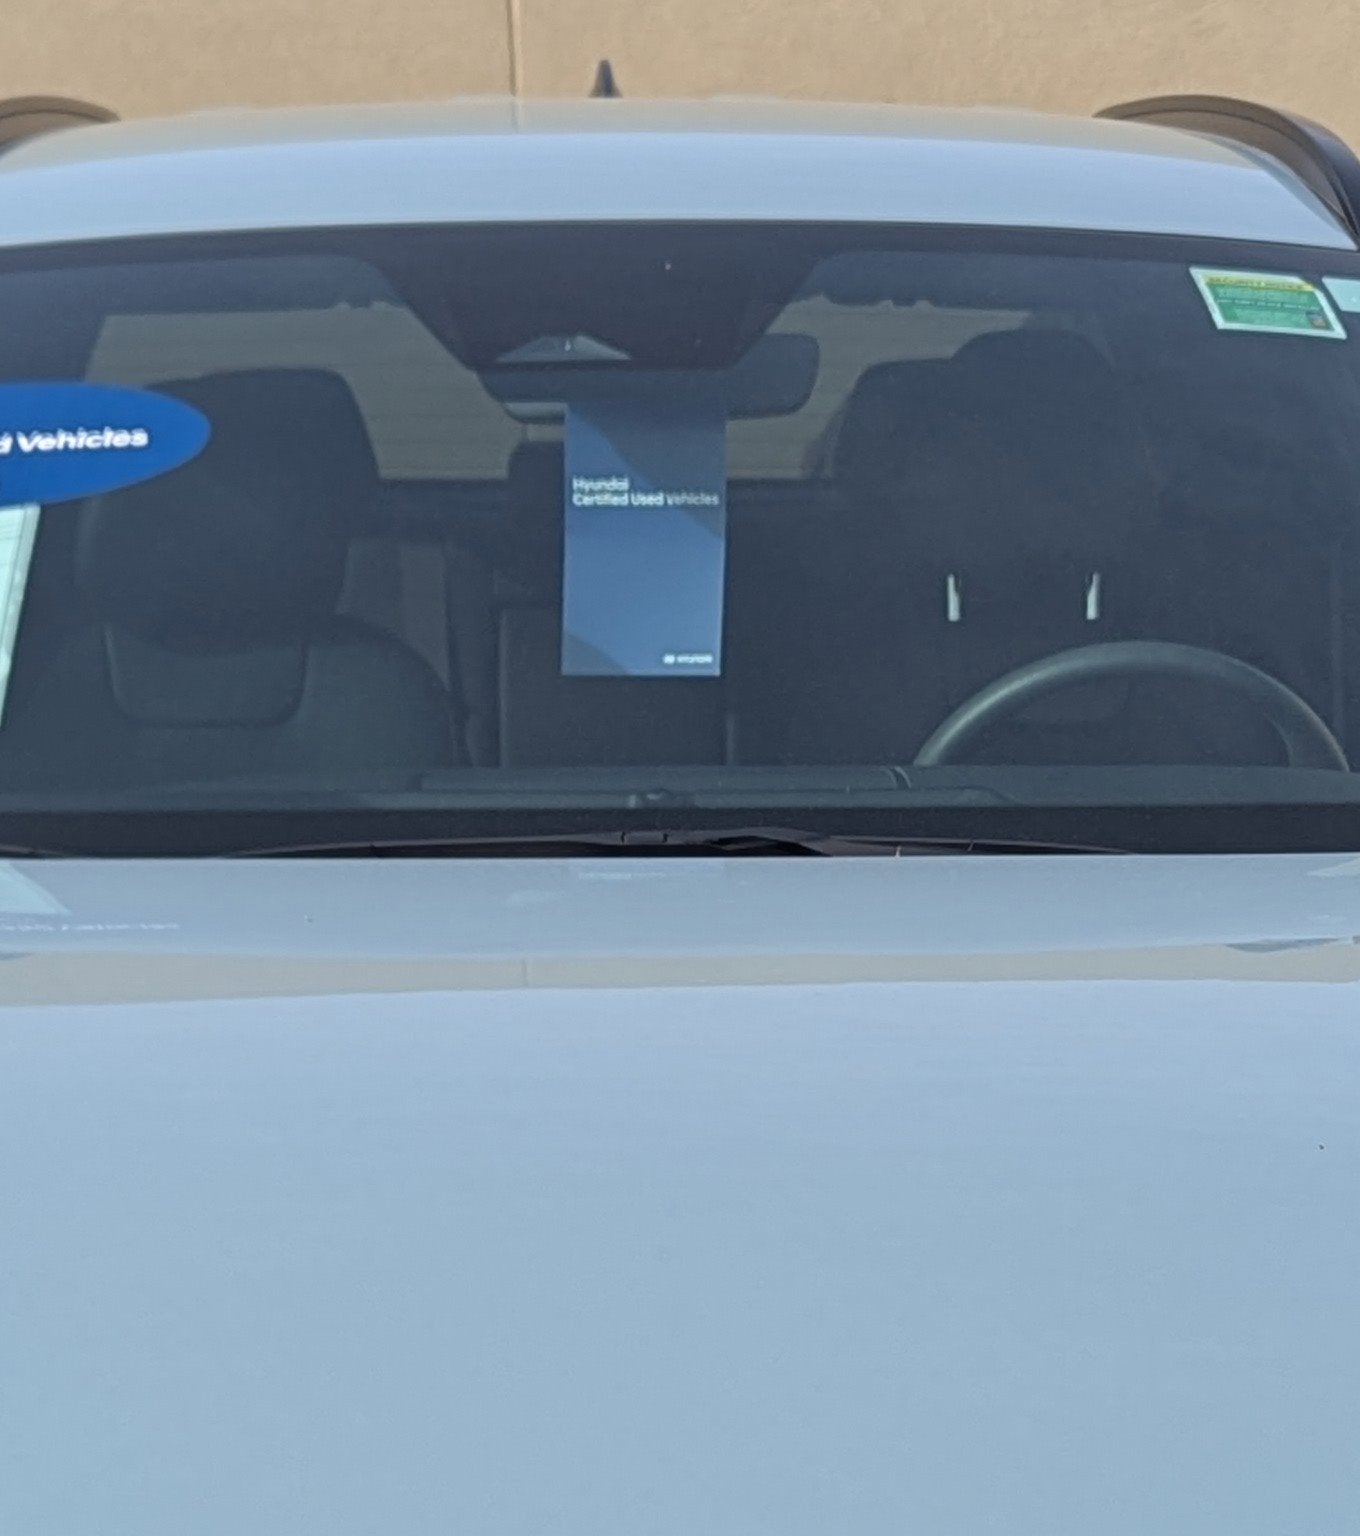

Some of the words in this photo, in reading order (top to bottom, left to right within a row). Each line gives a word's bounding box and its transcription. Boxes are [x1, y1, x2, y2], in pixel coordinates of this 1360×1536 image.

[16, 426, 149, 454] Vehicles
[572, 476, 630, 492] Hyundai
[572, 491, 629, 507] Certified
[630, 490, 665, 506] Used
[666, 490, 720, 506] Vehicles
